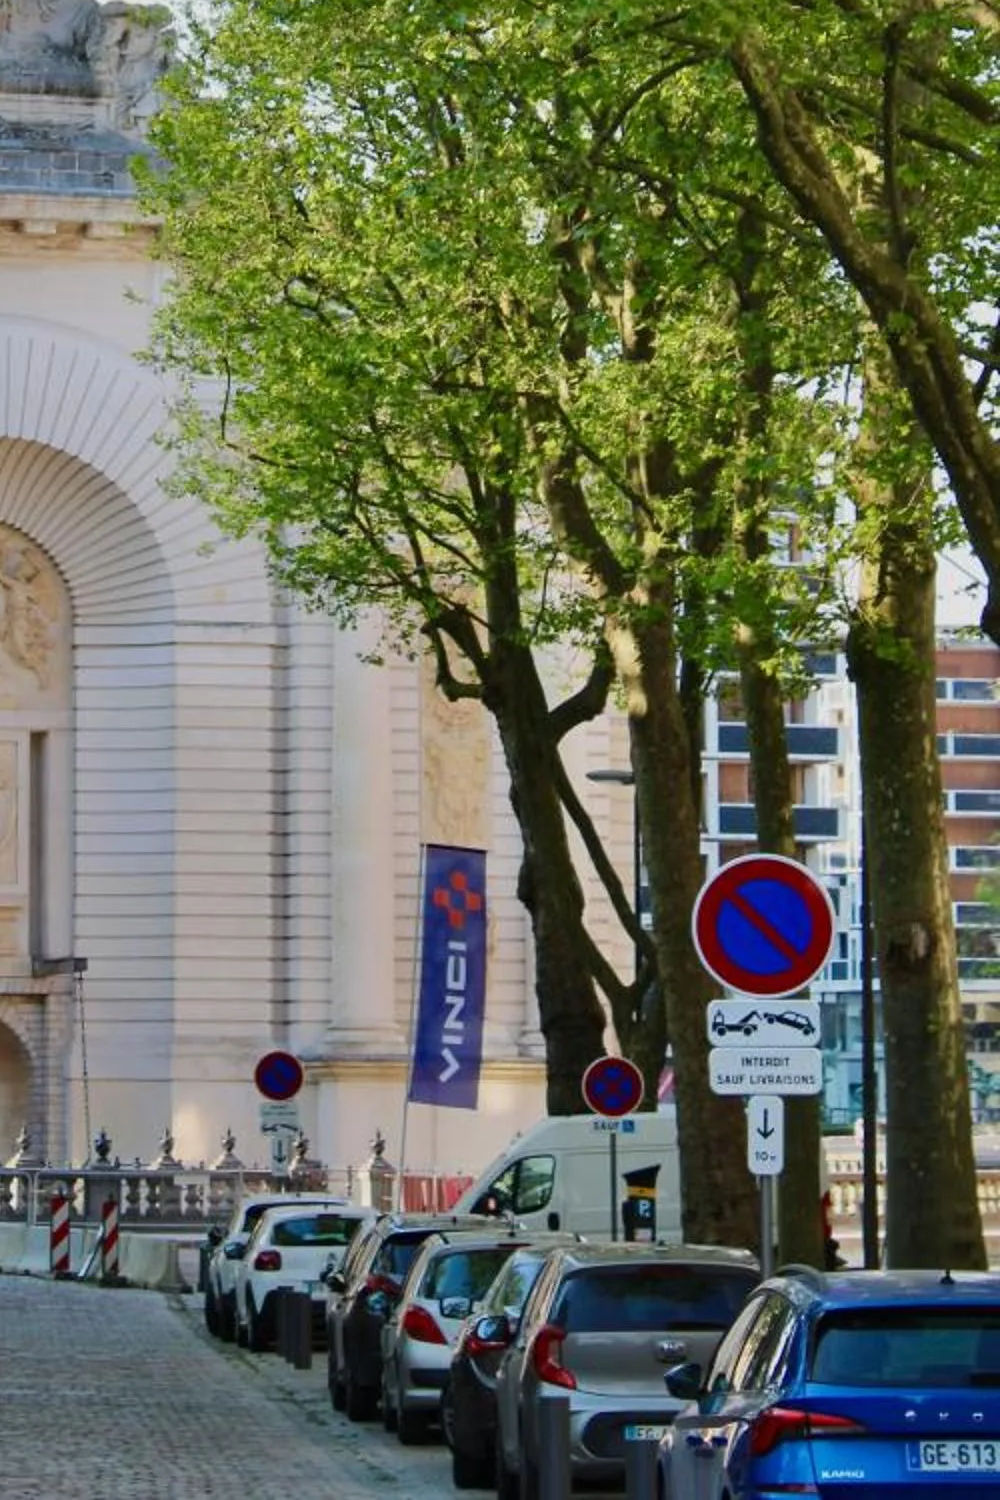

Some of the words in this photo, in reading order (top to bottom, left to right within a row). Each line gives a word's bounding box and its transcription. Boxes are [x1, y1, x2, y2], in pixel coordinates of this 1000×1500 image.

[438, 940, 468, 1083] VINCI
[740, 1057, 790, 1068] INTERDIT
[717, 1075, 744, 1085] SAUF
[748, 1075, 815, 1085] LIVRAISONS
